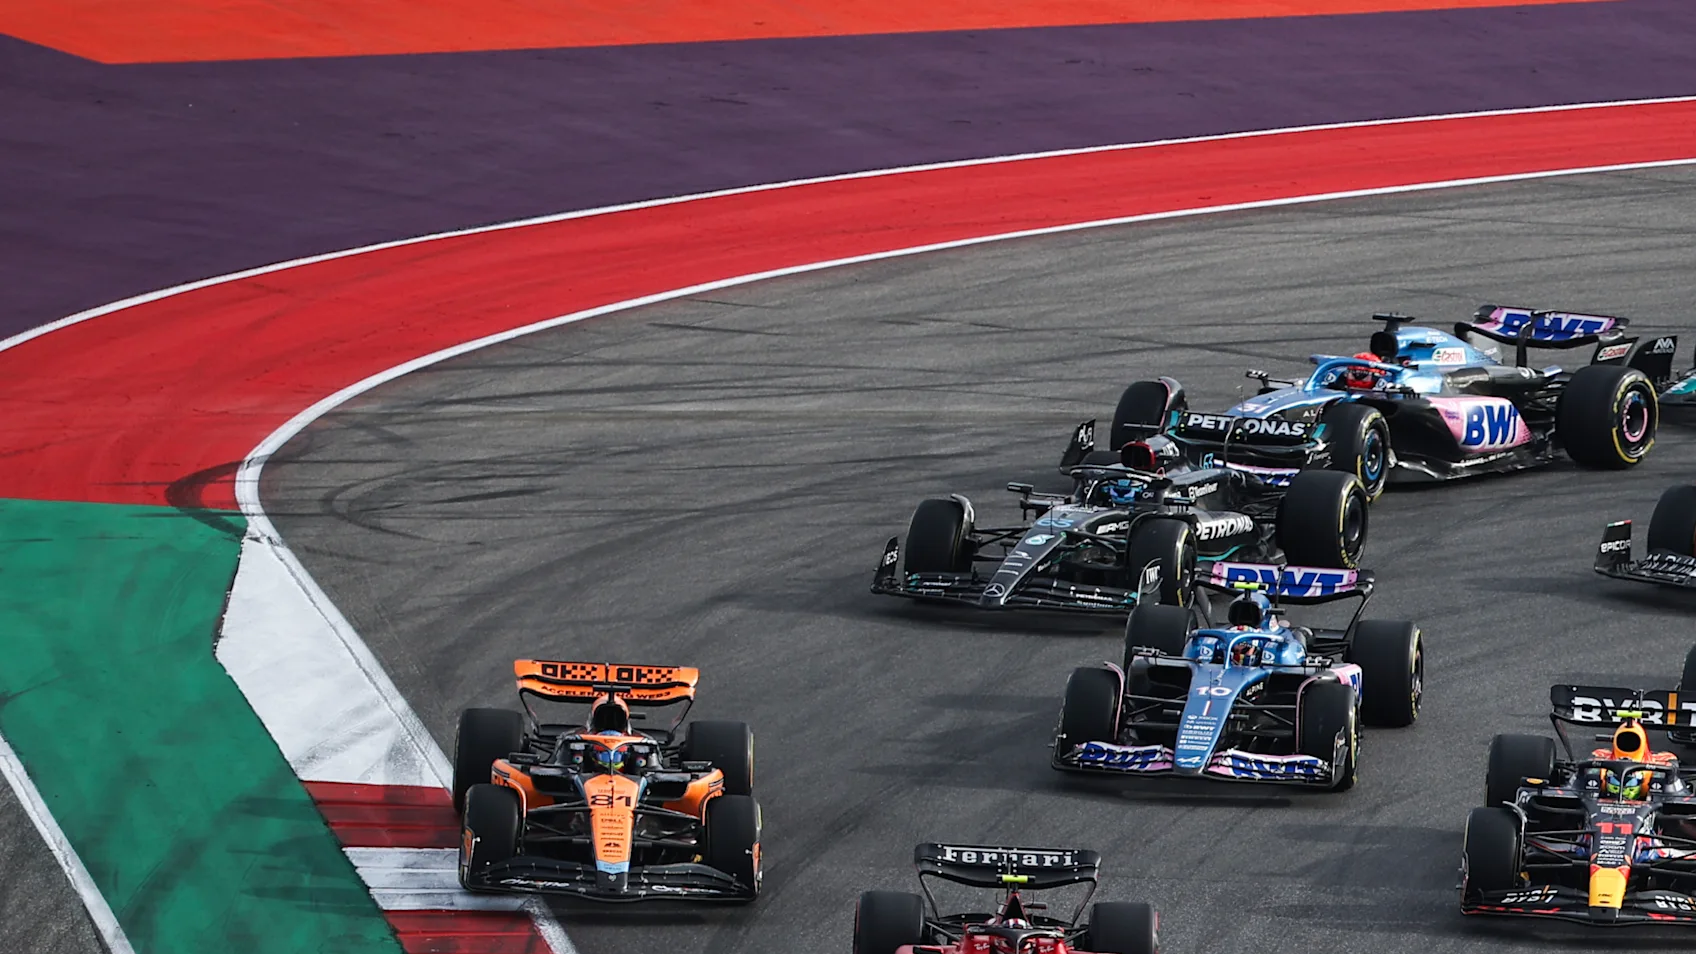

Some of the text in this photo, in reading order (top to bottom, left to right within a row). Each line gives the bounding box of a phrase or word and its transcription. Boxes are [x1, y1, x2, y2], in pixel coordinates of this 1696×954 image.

[1187, 413, 1305, 437] PETONAS
[1462, 404, 1519, 445] BWT
[1195, 686, 1232, 697] 10
[590, 794, 631, 809] 81
[1595, 822, 1634, 835] 11
[941, 846, 1074, 867] Ferrari
